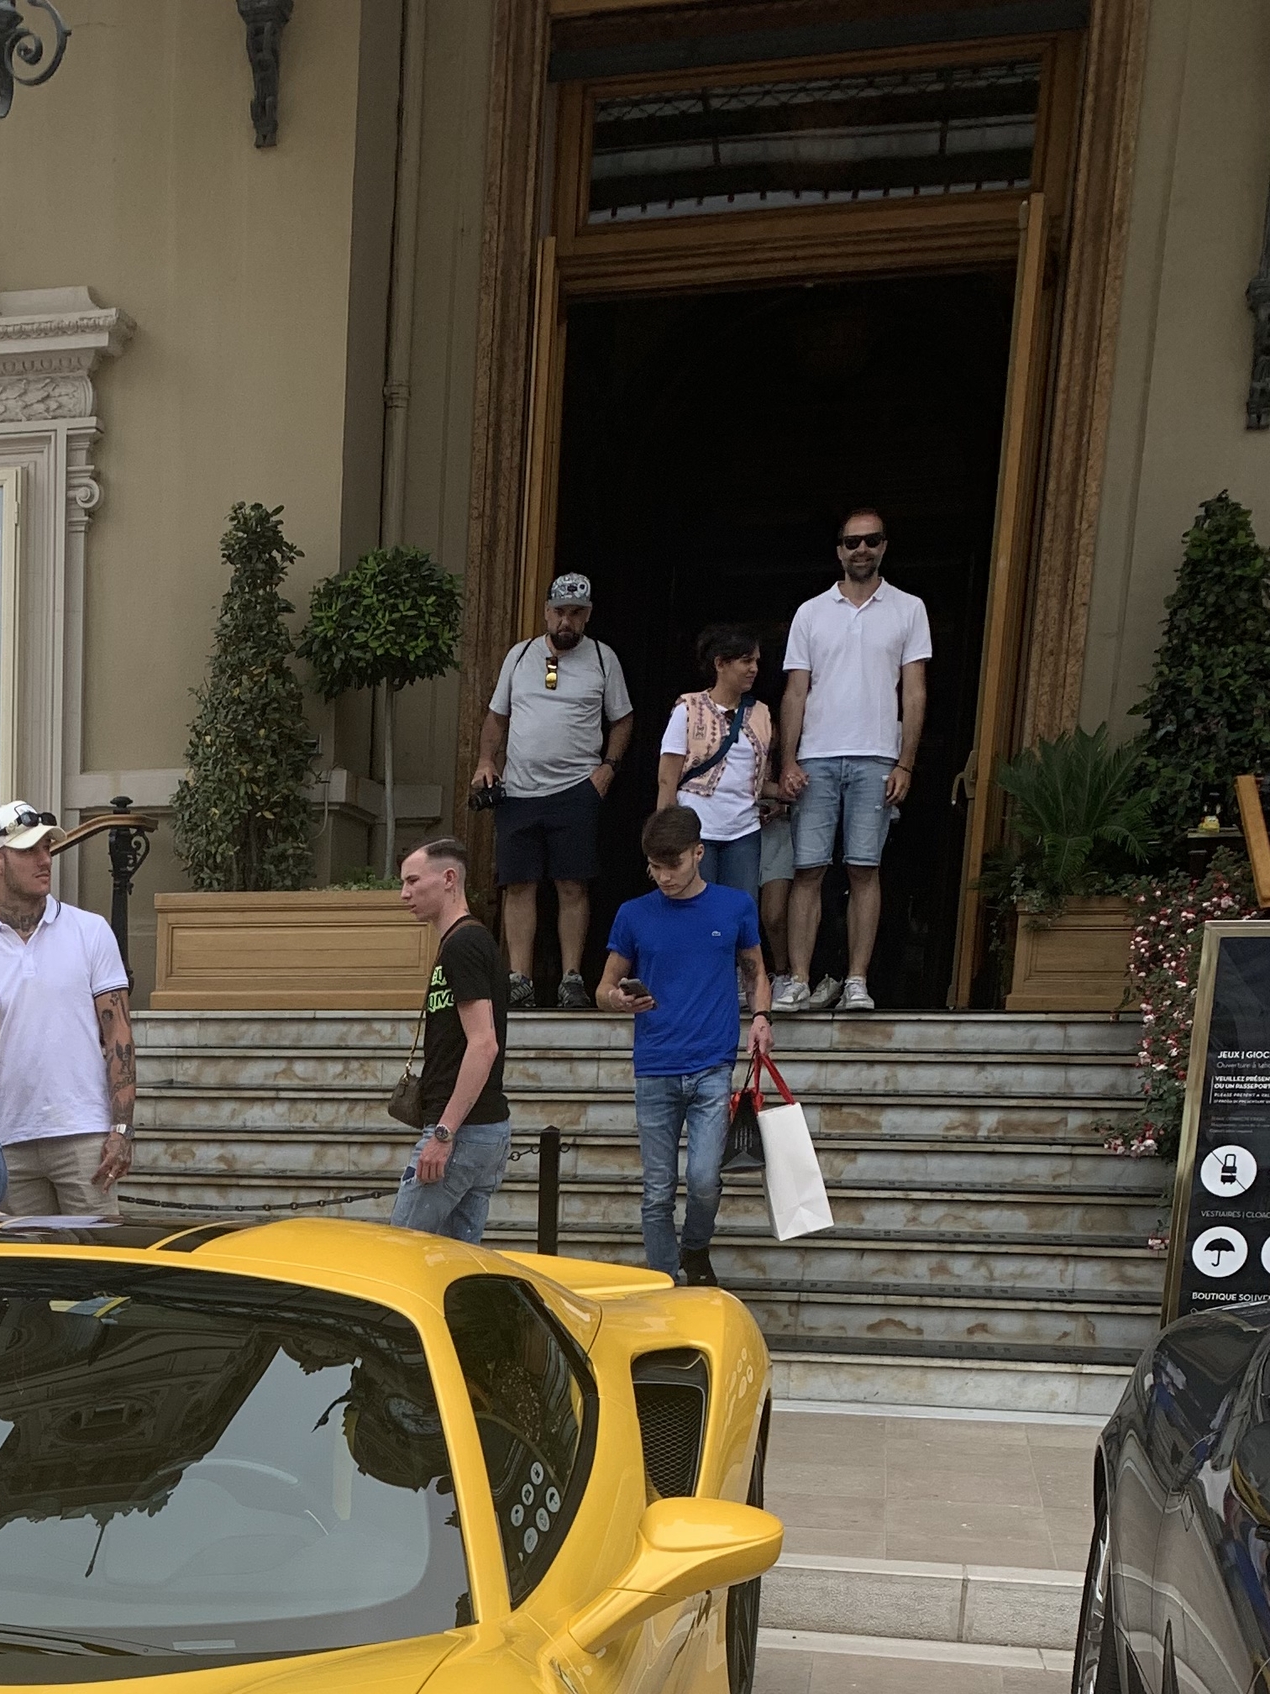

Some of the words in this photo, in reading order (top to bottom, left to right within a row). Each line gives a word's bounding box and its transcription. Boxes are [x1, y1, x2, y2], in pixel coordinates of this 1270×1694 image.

[1217, 1050, 1240, 1059] JEUX
[1201, 1210, 1241, 1218] VESTIAIRES
[1192, 1292, 1237, 1301] BOUTIQUE
